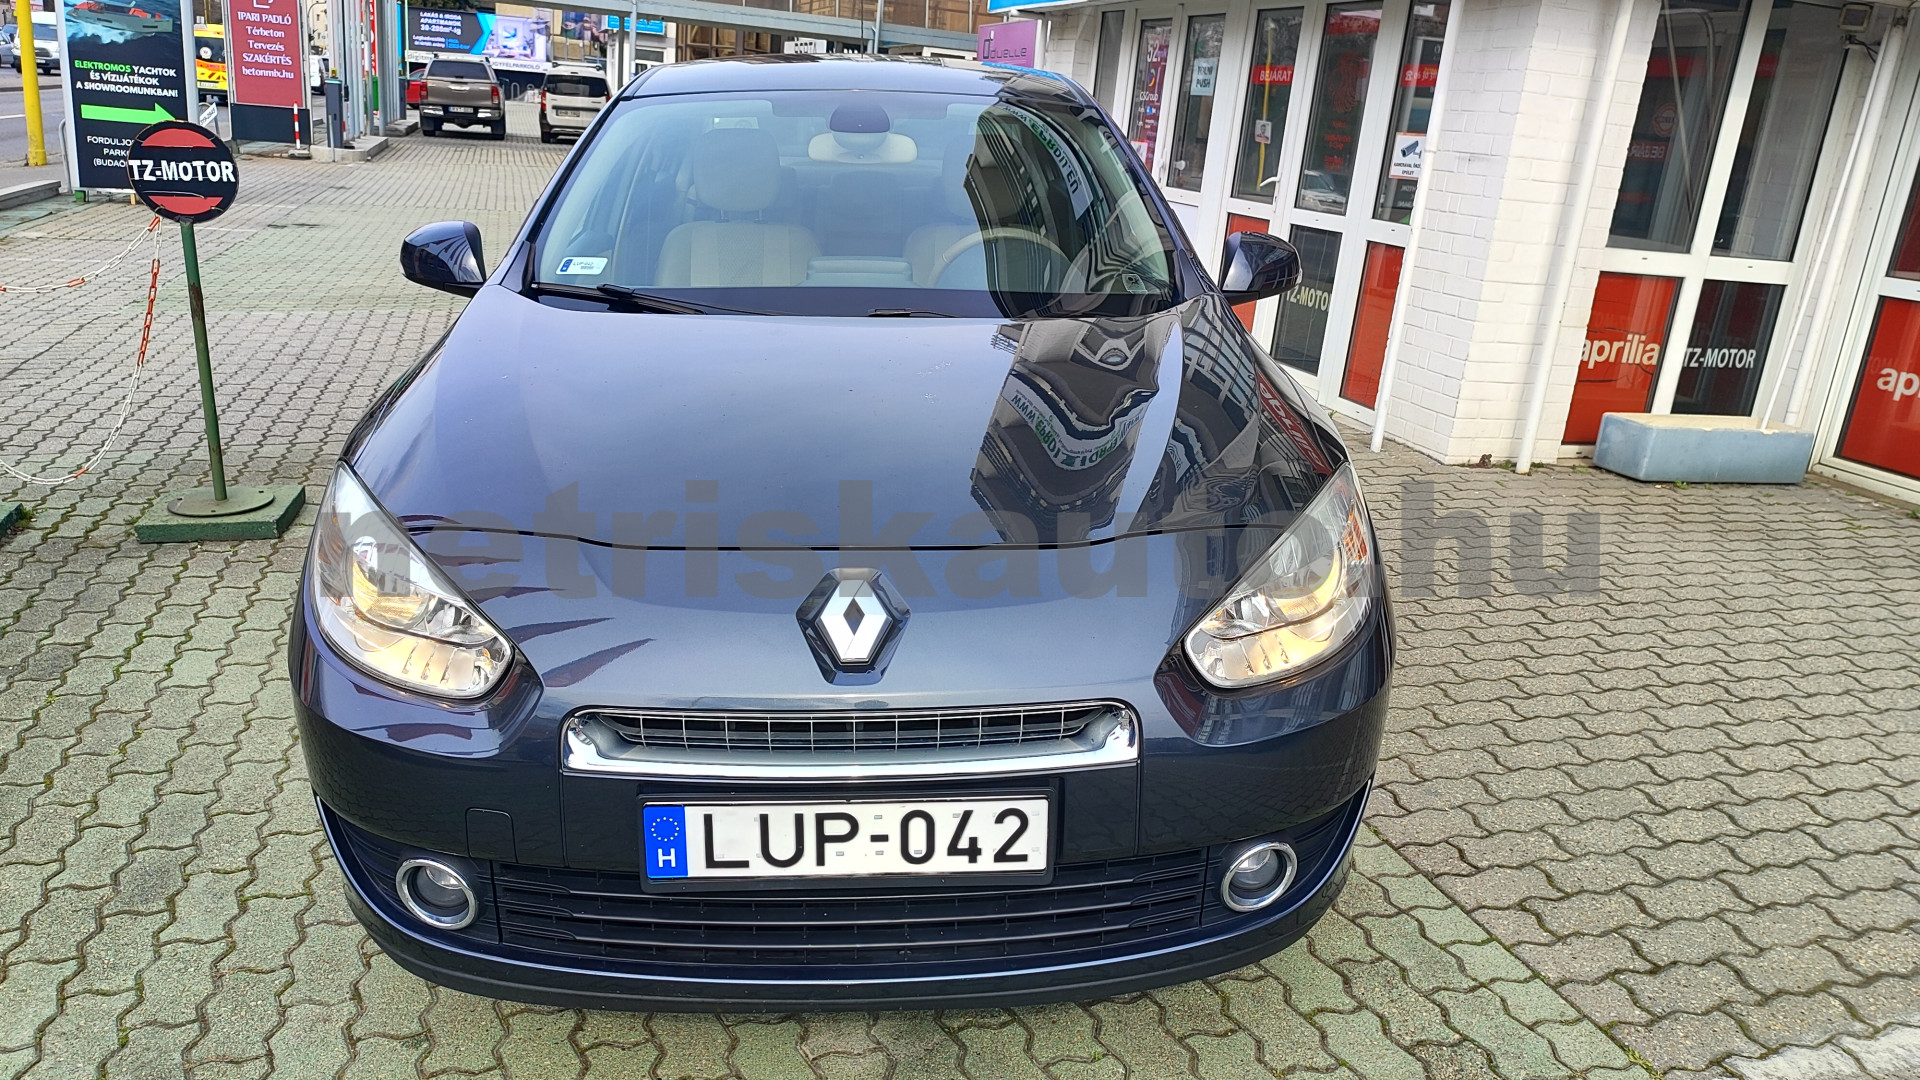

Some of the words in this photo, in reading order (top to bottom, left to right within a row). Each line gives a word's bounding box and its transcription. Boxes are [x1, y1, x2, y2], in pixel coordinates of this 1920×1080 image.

[237, 11, 260, 22] IPARI
[262, 13, 292, 25] PADLÓ
[245, 25, 285, 38] Térbeton
[247, 39, 285, 52] Tervezés
[242, 52, 293, 66] SZAKÉRTÉS
[74, 60, 131, 73] ELEKTROMOS
[132, 65, 177, 77] YACHTOK
[89, 71, 100, 80] ÉS
[75, 81, 83, 90] A
[84, 82, 178, 98] SHOWROOMUNKBAN!
[87, 135, 134, 147] FORDULJO
[128, 159, 236, 182] TZ-MOTOR
[1580, 333, 1661, 369] aprilia
[1682, 347, 1757, 369] TZ-MOTOR
[1876, 366, 1920, 402] ap
[703, 808, 1029, 869] LUP-042
[657, 848, 676, 868] H
